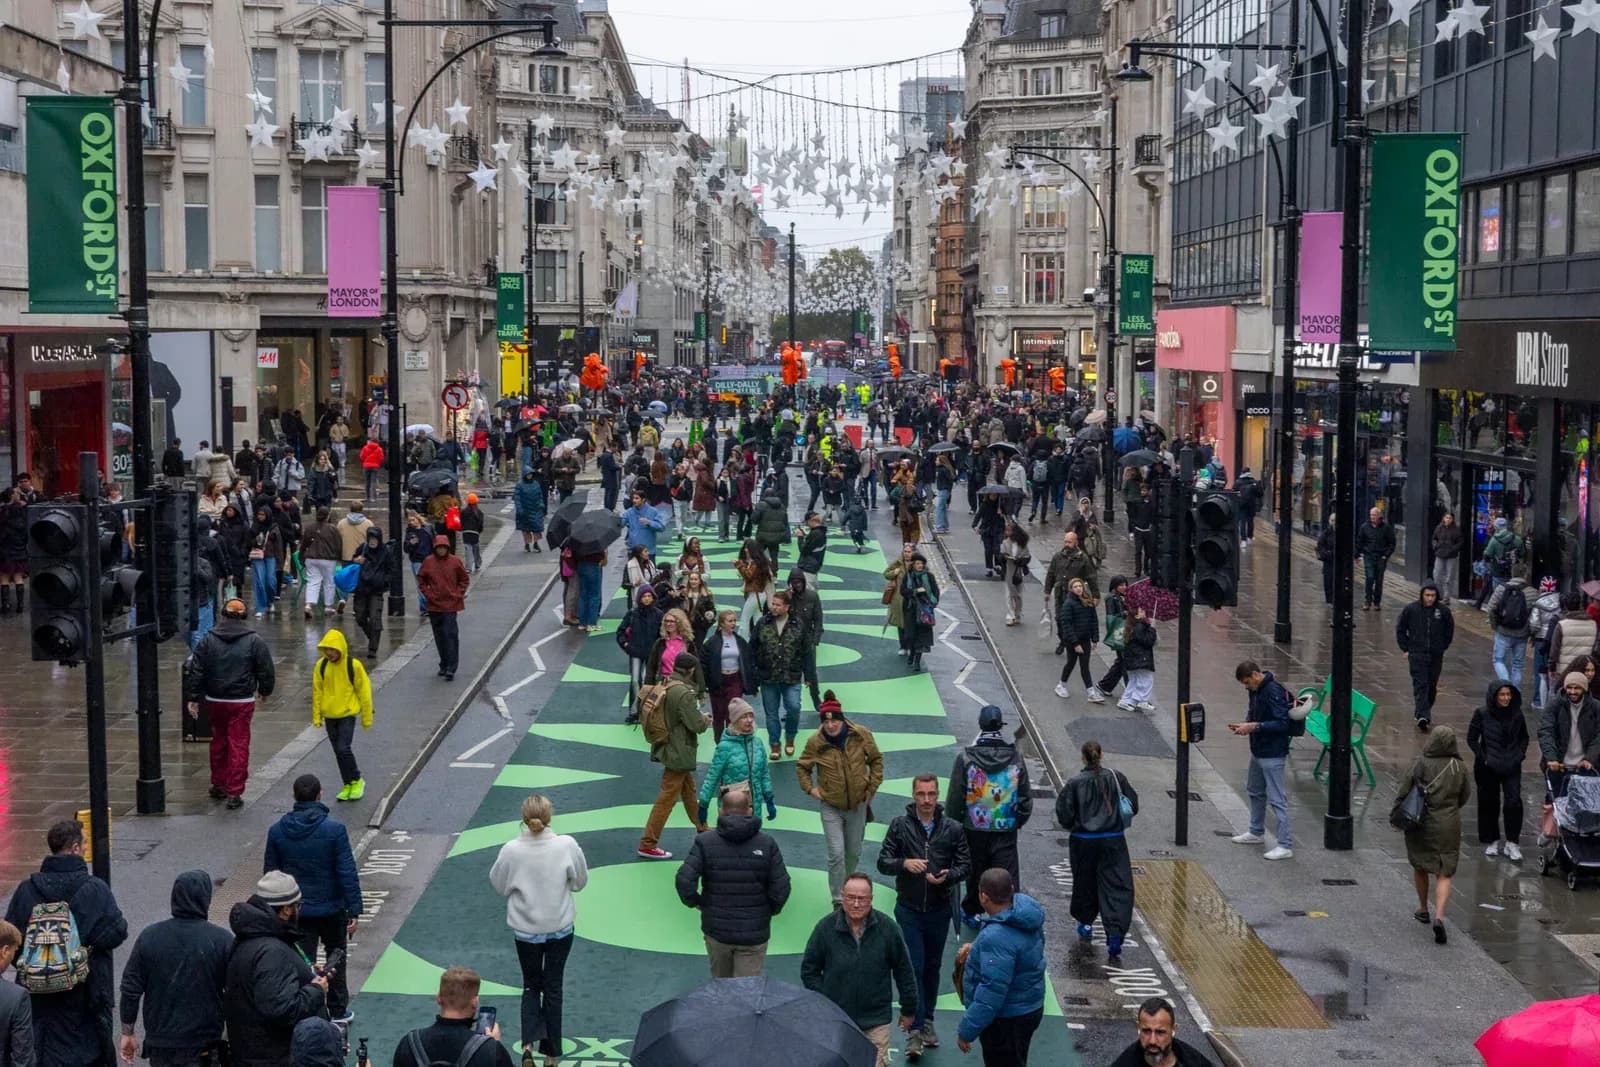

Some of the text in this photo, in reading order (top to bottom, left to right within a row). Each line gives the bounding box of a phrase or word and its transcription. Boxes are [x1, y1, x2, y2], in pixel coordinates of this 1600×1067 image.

[80, 112, 116, 271] OXFORD
[1423, 148, 1459, 309] OXFORD
[1125, 259, 1150, 267] MORE
[1125, 266, 1150, 274] SPACE
[500, 276, 521, 284] MORE
[330, 288, 368, 297] MAYOR
[330, 298, 379, 307] LONDON
[1127, 315, 1146, 323] LESS
[1302, 315, 1341, 324] MAYOR
[1120, 322, 1152, 330] TRAFFIC
[1302, 325, 1341, 334] LONDO
[259, 352, 277, 364] H&M
[1516, 331, 1569, 388] NBA Store
[715, 381, 760, 389] DILLY-DALLY
[1246, 407, 1270, 415] ecco
[357, 849, 417, 876] LOOK
